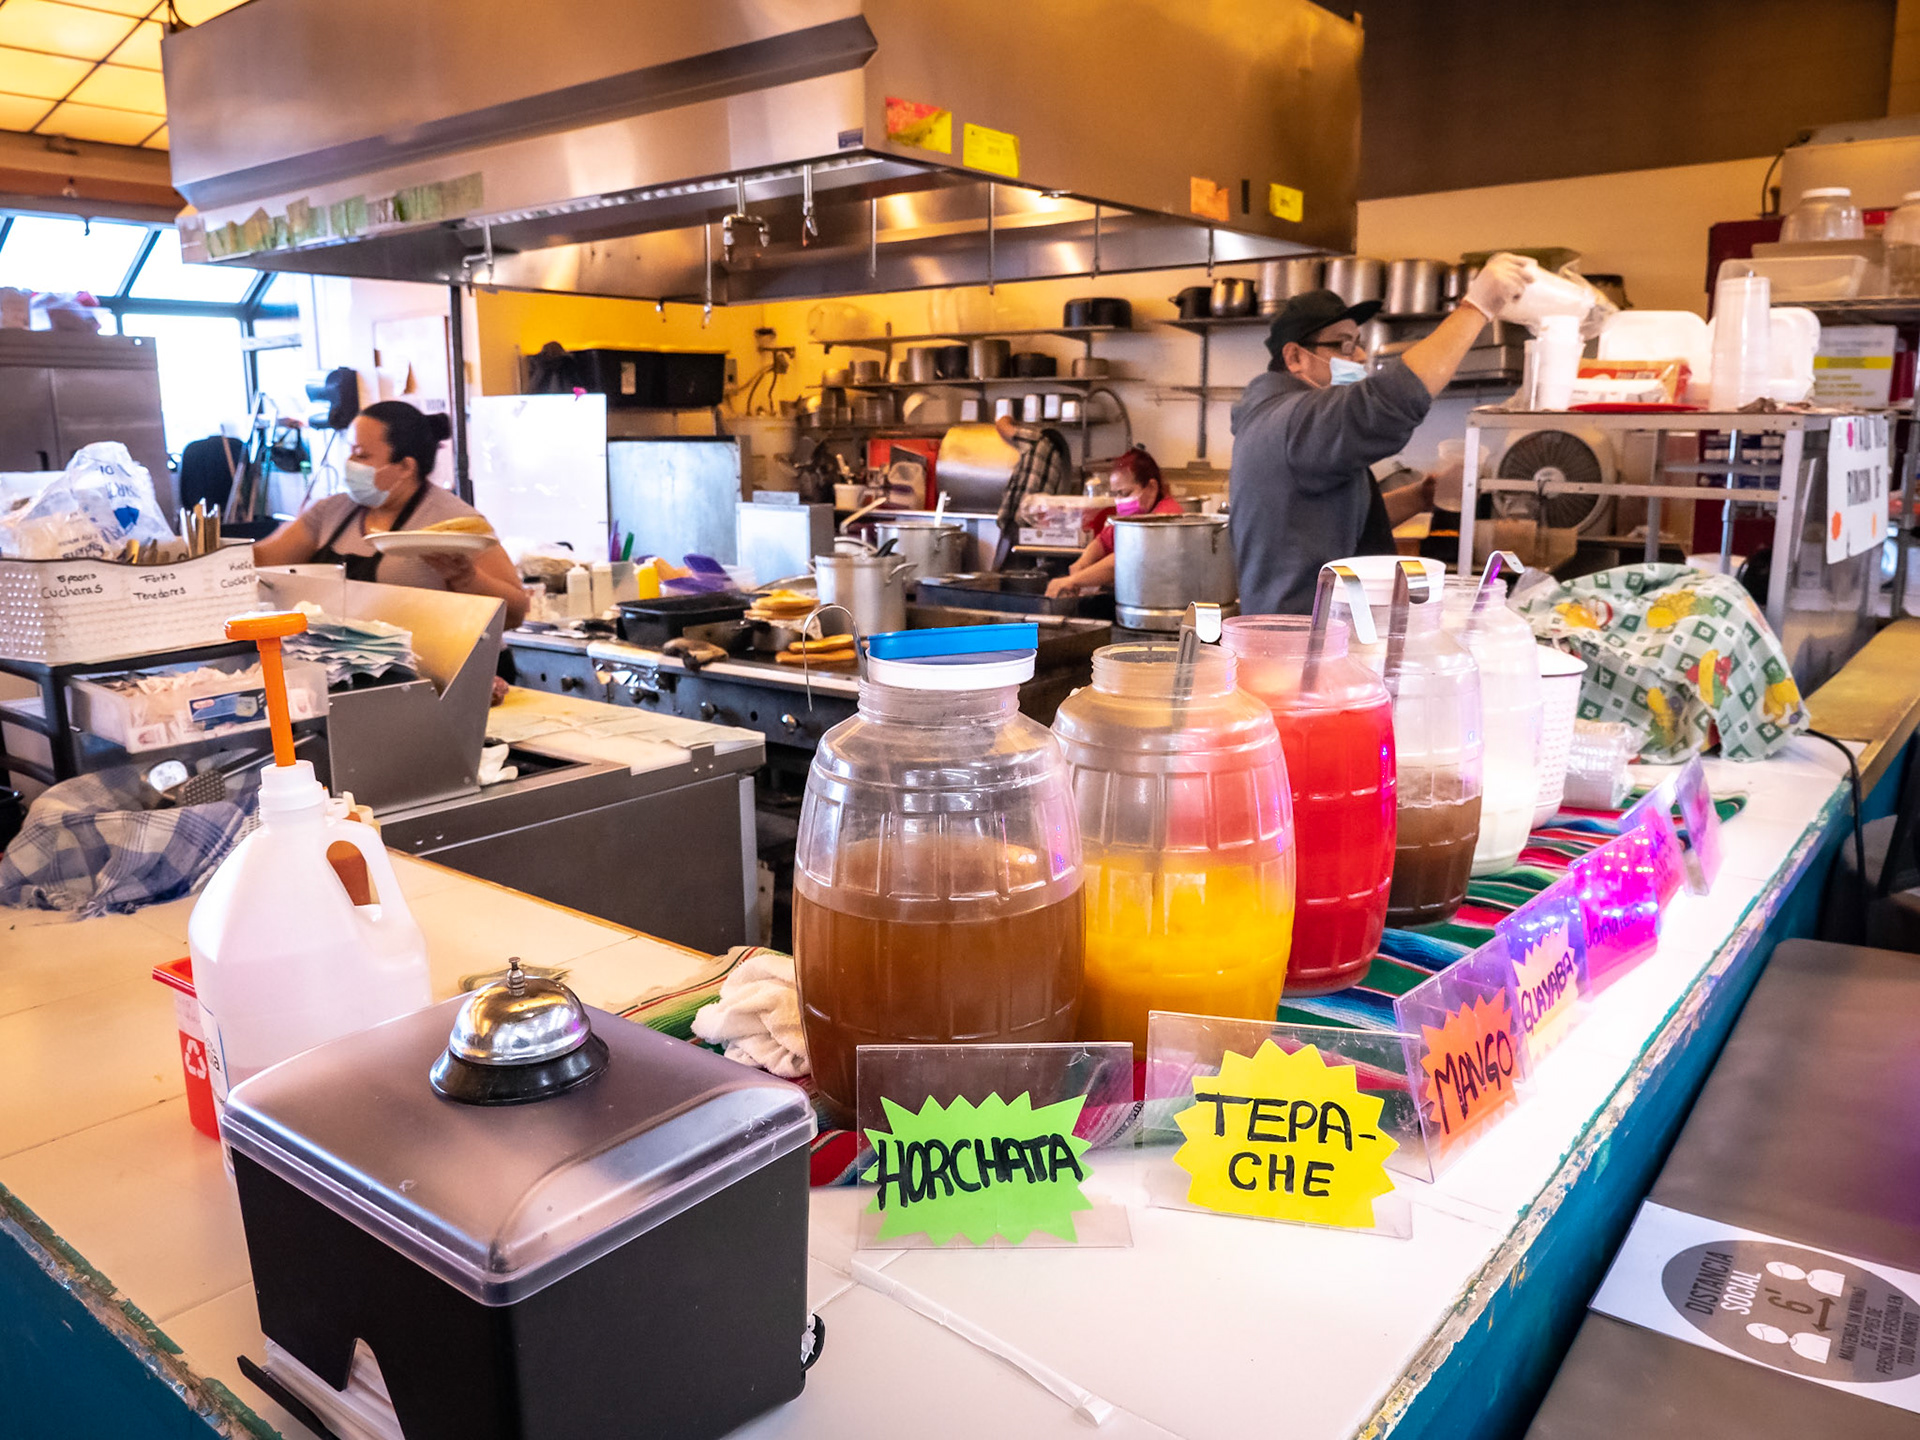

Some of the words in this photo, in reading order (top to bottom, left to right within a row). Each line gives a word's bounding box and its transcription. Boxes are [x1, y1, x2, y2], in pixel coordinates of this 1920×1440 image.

[41, 584, 103, 600] Cucharas
[133, 587, 186, 600] Tenedores
[1584, 903, 1643, 949] Jamaica
[1521, 951, 1574, 1036] GUAYABA
[1434, 1029, 1513, 1135] MANGO
[876, 1133, 1083, 1211] HORCHATA
[1228, 1152, 1335, 1197] CHE
[1685, 1251, 1733, 1316] DISTANCIA
[1720, 1270, 1762, 1315] SOCIAL
[1887, 1293, 1903, 1306] EN
[1765, 1287, 1814, 1315] 6'
[1866, 1306, 1883, 1318] DE
[1846, 1312, 1863, 1325] UN
[1863, 1316, 1881, 1335] PIES
[1882, 1304, 1901, 1337] PERSONA
[1900, 1311, 1920, 1349] MOMENTO
[1838, 1322, 1860, 1362] MANTENGA
[1861, 1339, 1877, 1350] DE
[1876, 1341, 1896, 1376] PERSONA
[1897, 1346, 1916, 1367] TODO
